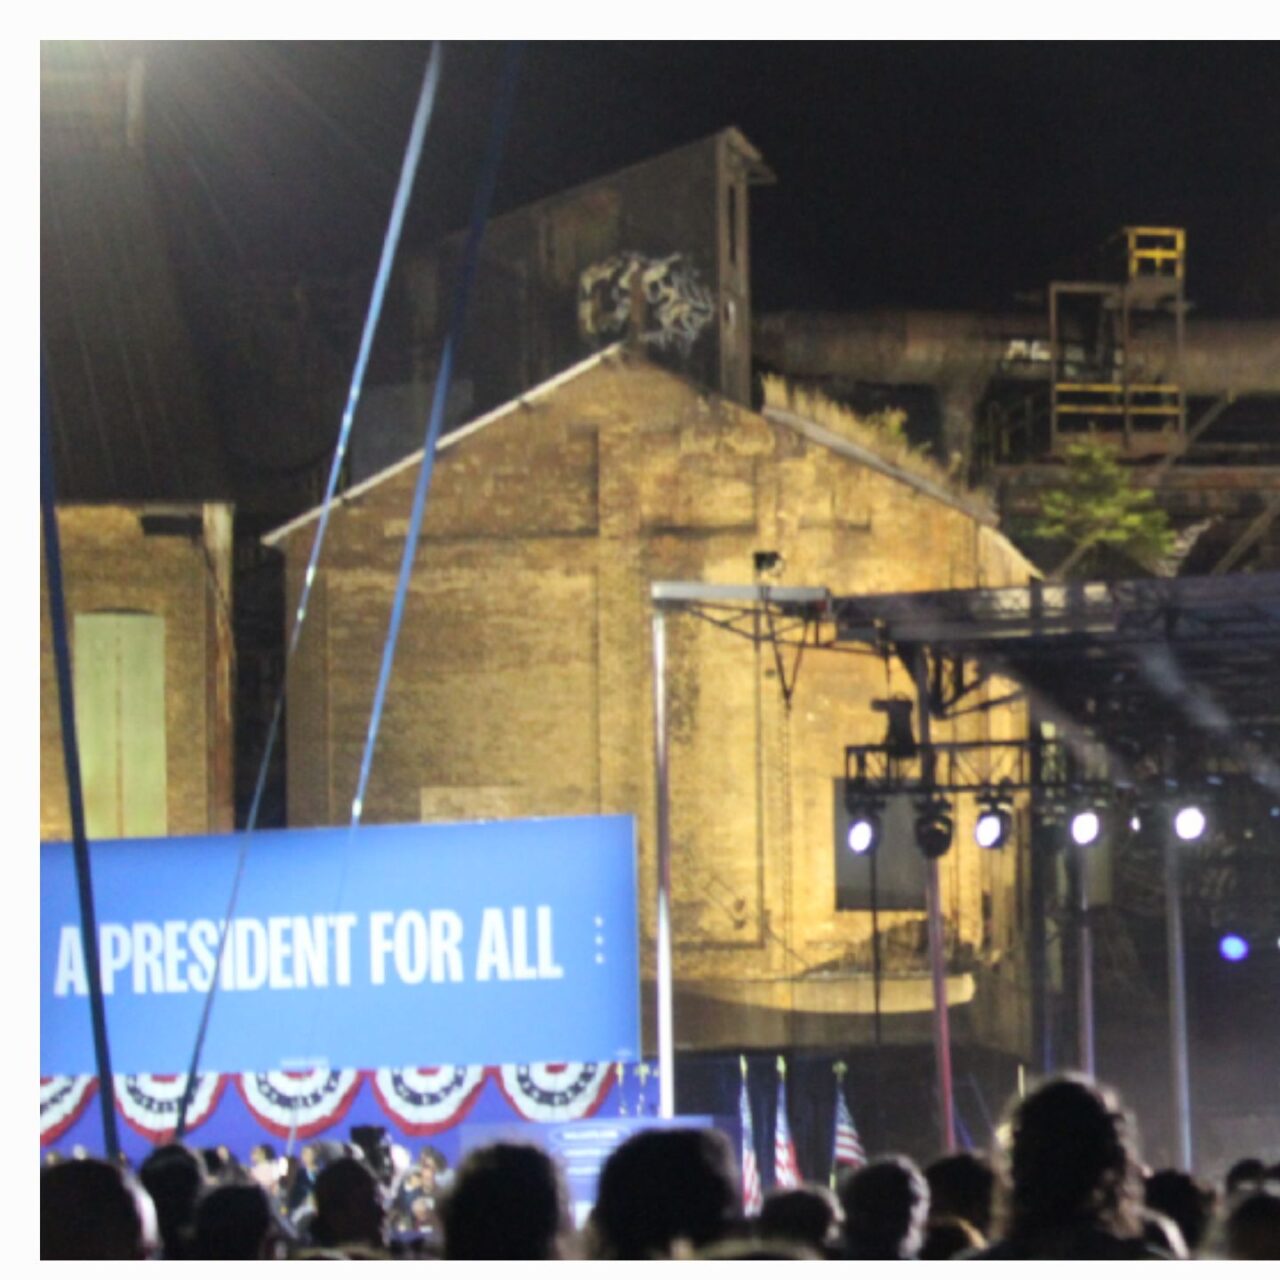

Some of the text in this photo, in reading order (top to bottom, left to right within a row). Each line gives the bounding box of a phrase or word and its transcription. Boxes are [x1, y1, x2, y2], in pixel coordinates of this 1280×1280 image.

[54, 905, 564, 996] A PRESIDENT FOR ALL
